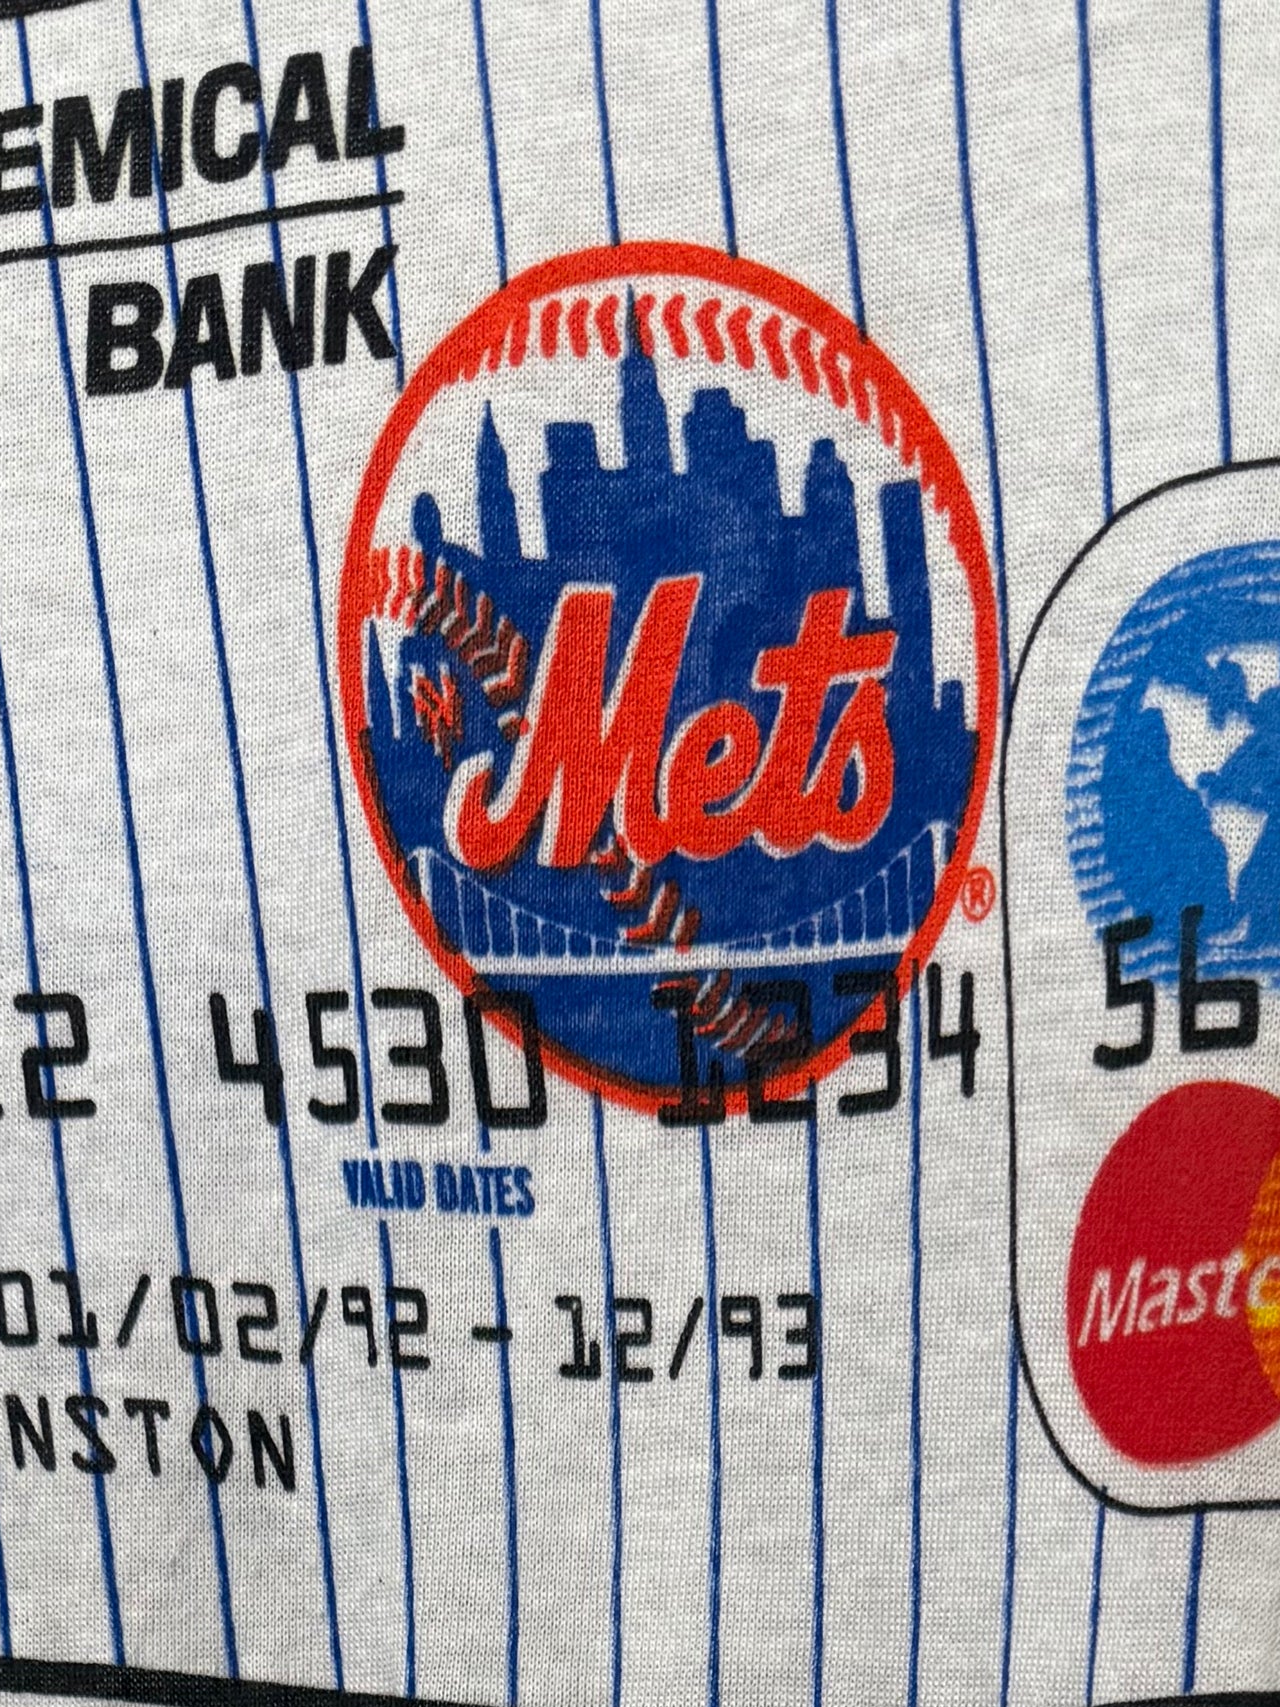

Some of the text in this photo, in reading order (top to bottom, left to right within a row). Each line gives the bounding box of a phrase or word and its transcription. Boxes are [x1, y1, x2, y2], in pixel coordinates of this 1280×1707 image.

[85, 245, 399, 398] BANK
[444, 573, 900, 877] Mets
[208, 990, 547, 1131] 4530
[650, 962, 981, 1128] 1234
[342, 1159, 536, 1218] VALID DATES
[554, 1293, 819, 1382] 12/93
